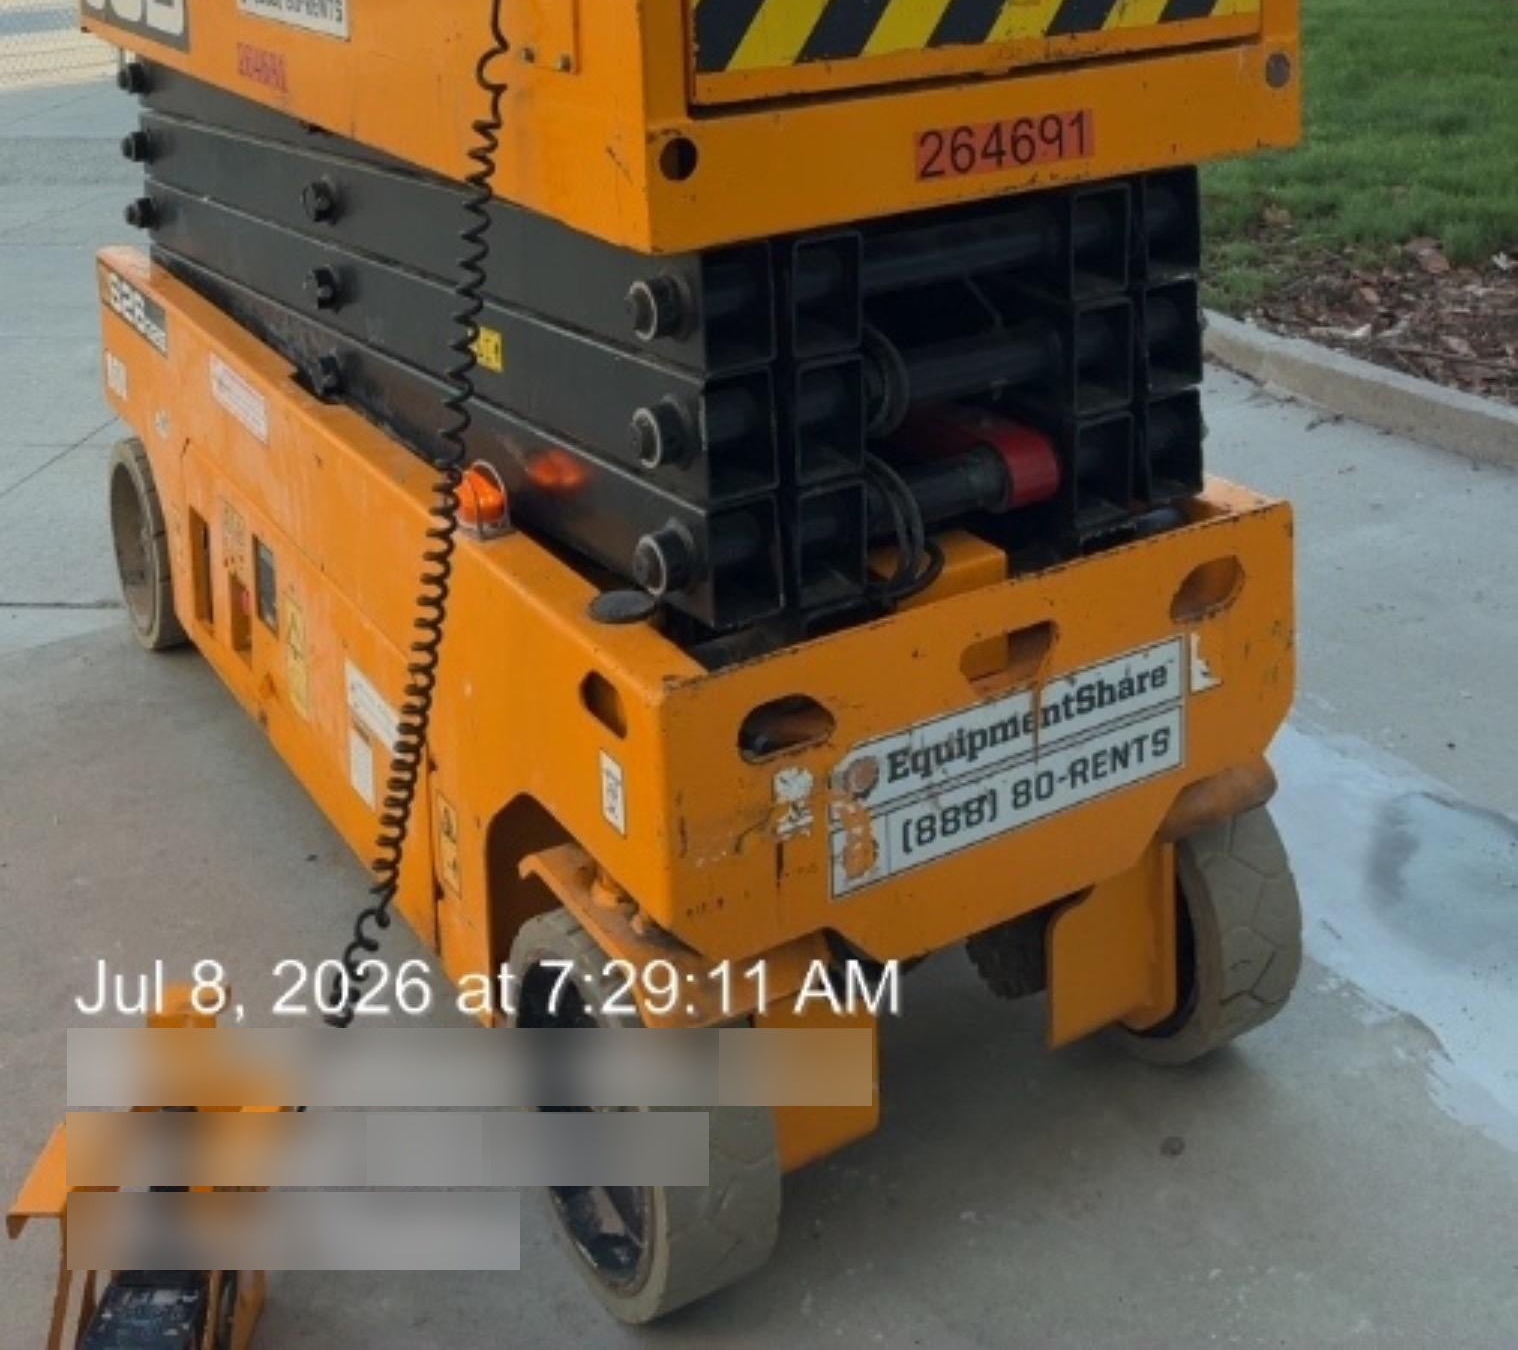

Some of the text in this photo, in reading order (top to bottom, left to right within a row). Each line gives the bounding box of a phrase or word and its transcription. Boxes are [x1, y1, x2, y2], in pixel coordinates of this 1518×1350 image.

[918, 109, 1087, 179] 264691
[901, 727, 1171, 853] (888) 80-RENTS
